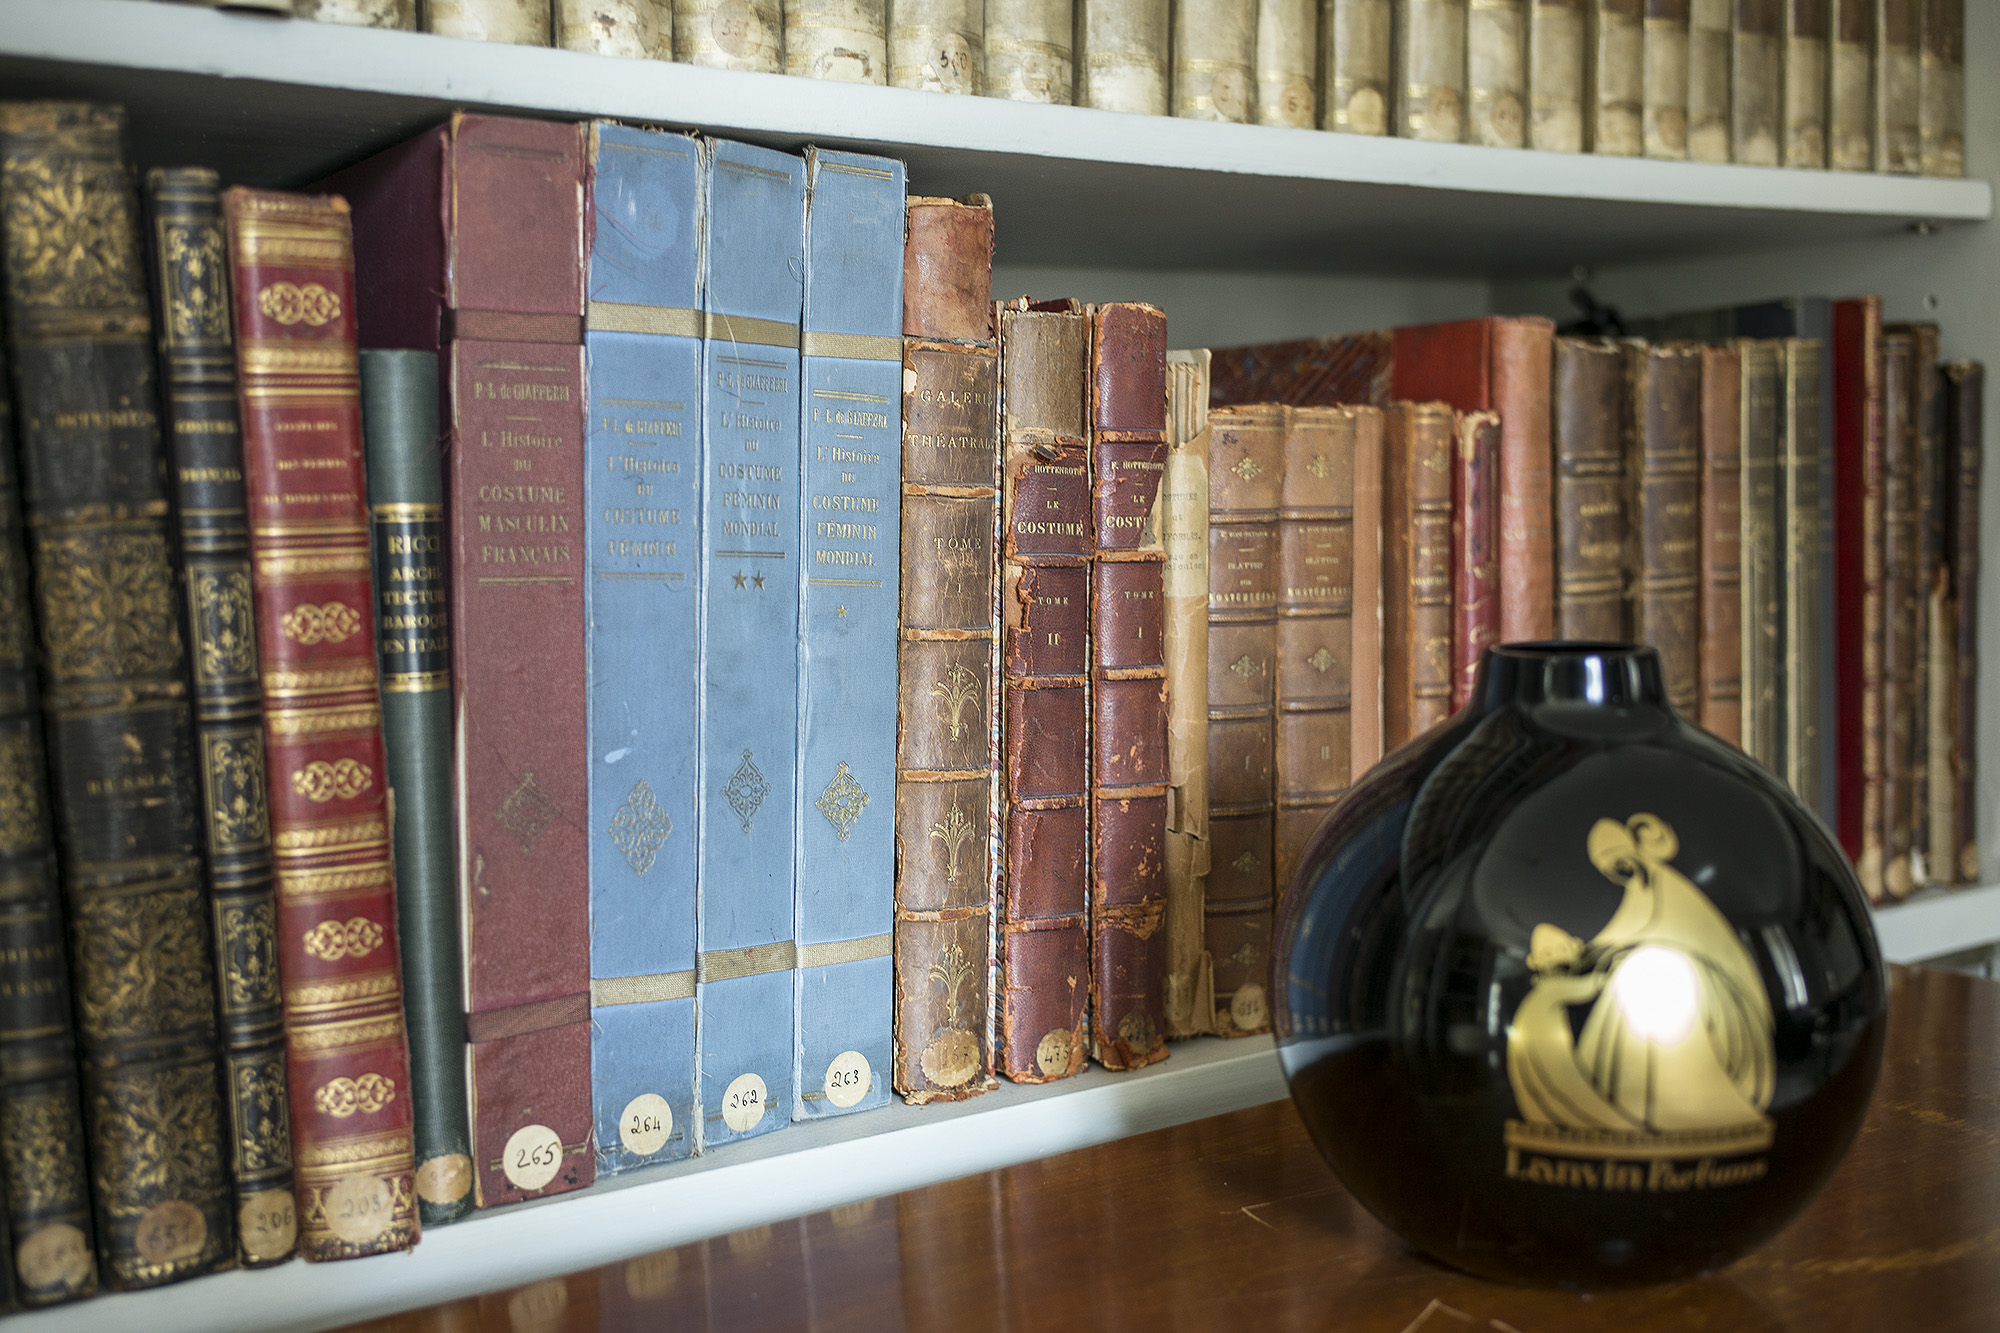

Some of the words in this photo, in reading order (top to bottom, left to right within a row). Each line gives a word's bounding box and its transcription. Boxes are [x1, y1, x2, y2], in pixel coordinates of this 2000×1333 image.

[744, 439, 759, 452] DU
[513, 459, 532, 472] DU
[719, 463, 783, 482] COSTUME
[841, 471, 856, 484] DU
[479, 484, 567, 503] COSTUME
[636, 483, 654, 496] DU
[723, 488, 780, 510] FÉMININ
[1133, 494, 1145, 504] LE
[813, 494, 880, 513] COSTUME
[1046, 500, 1060, 509] LE
[478, 514, 569, 533] MASCULIN
[604, 507, 682, 526] COSTUME
[722, 519, 781, 537] MONDIAL
[816, 519, 877, 540] FÉMININ
[1017, 521, 1084, 536] COSTUME
[608, 538, 677, 558] FÉMININ
[933, 537, 982, 550] TOME
[482, 545, 570, 567] FRANÇAIS
[815, 549, 876, 567] MONDIAL
[1037, 596, 1069, 606] TOME
[1124, 590, 1154, 600] TOME
[1047, 632, 1060, 647] II
[831, 1069, 859, 1088] 263
[730, 1089, 759, 1109] 262
[631, 1115, 661, 1134] 264
[517, 1142, 558, 1168] 265
[1507, 1148, 1644, 1191] Lanvin
